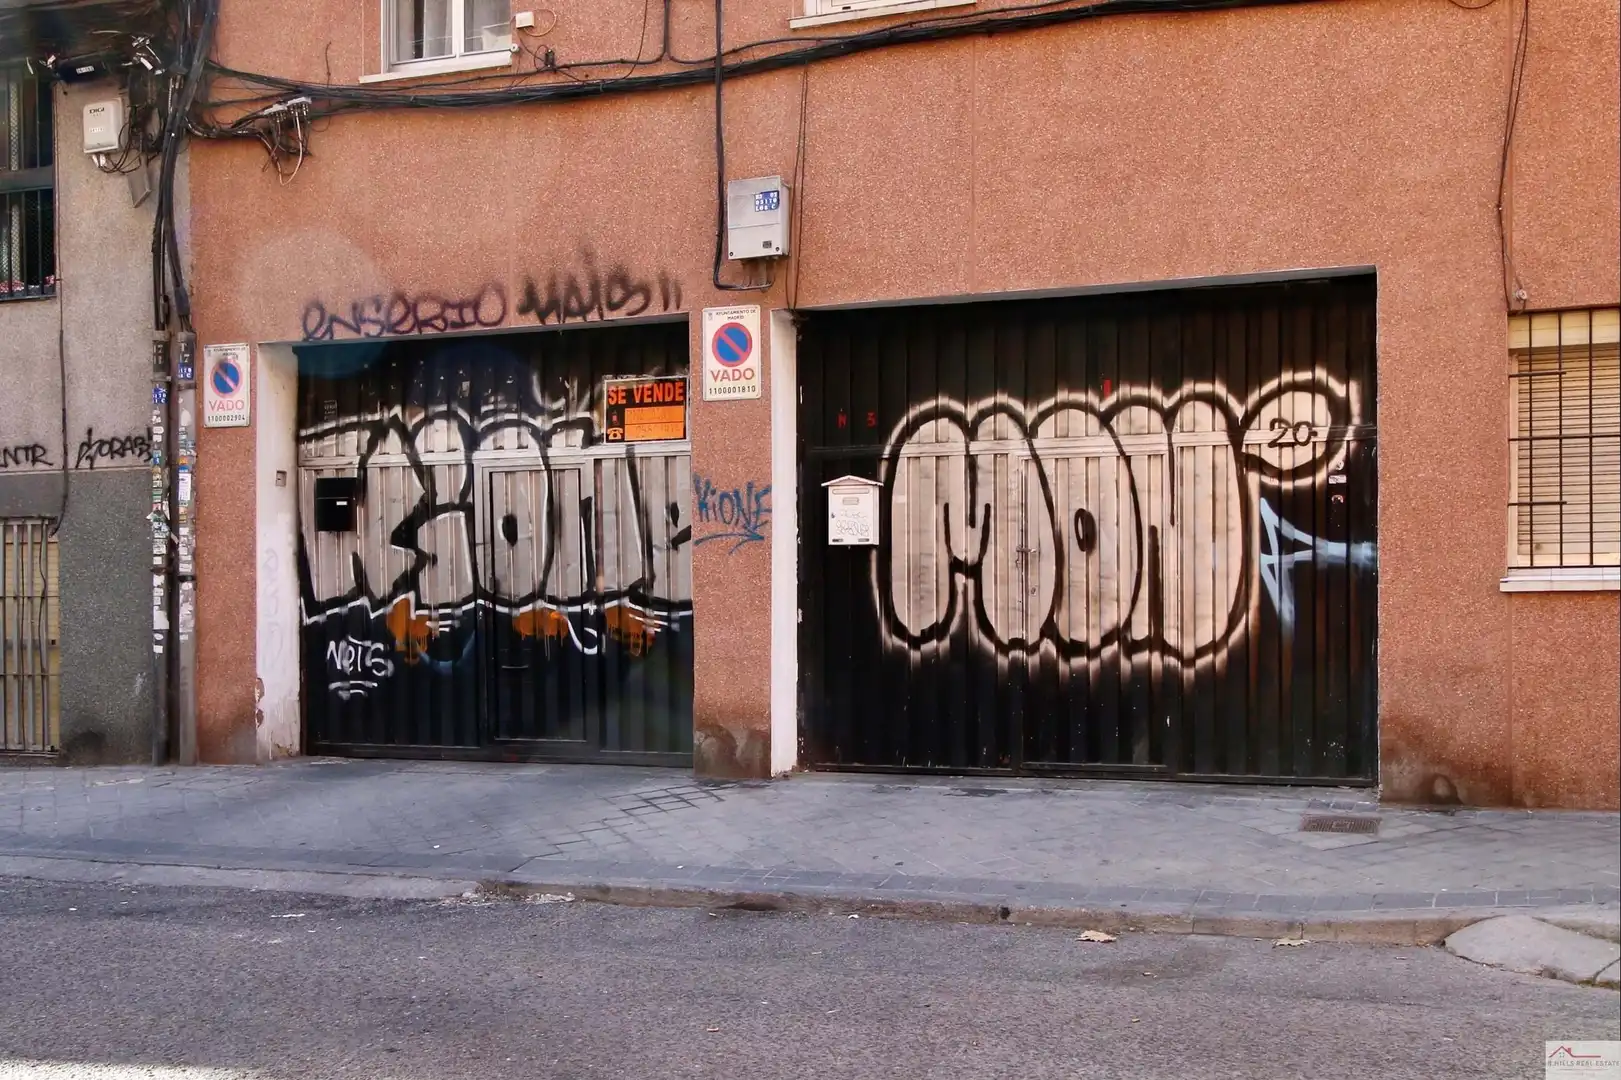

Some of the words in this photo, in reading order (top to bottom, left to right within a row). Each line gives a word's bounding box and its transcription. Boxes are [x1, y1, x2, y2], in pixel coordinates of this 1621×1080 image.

[710, 367, 754, 383] VADO
[608, 385, 626, 405] SE
[633, 381, 685, 404] VENDE
[709, 385, 757, 395] 1100001810
[209, 400, 244, 412] VADO
